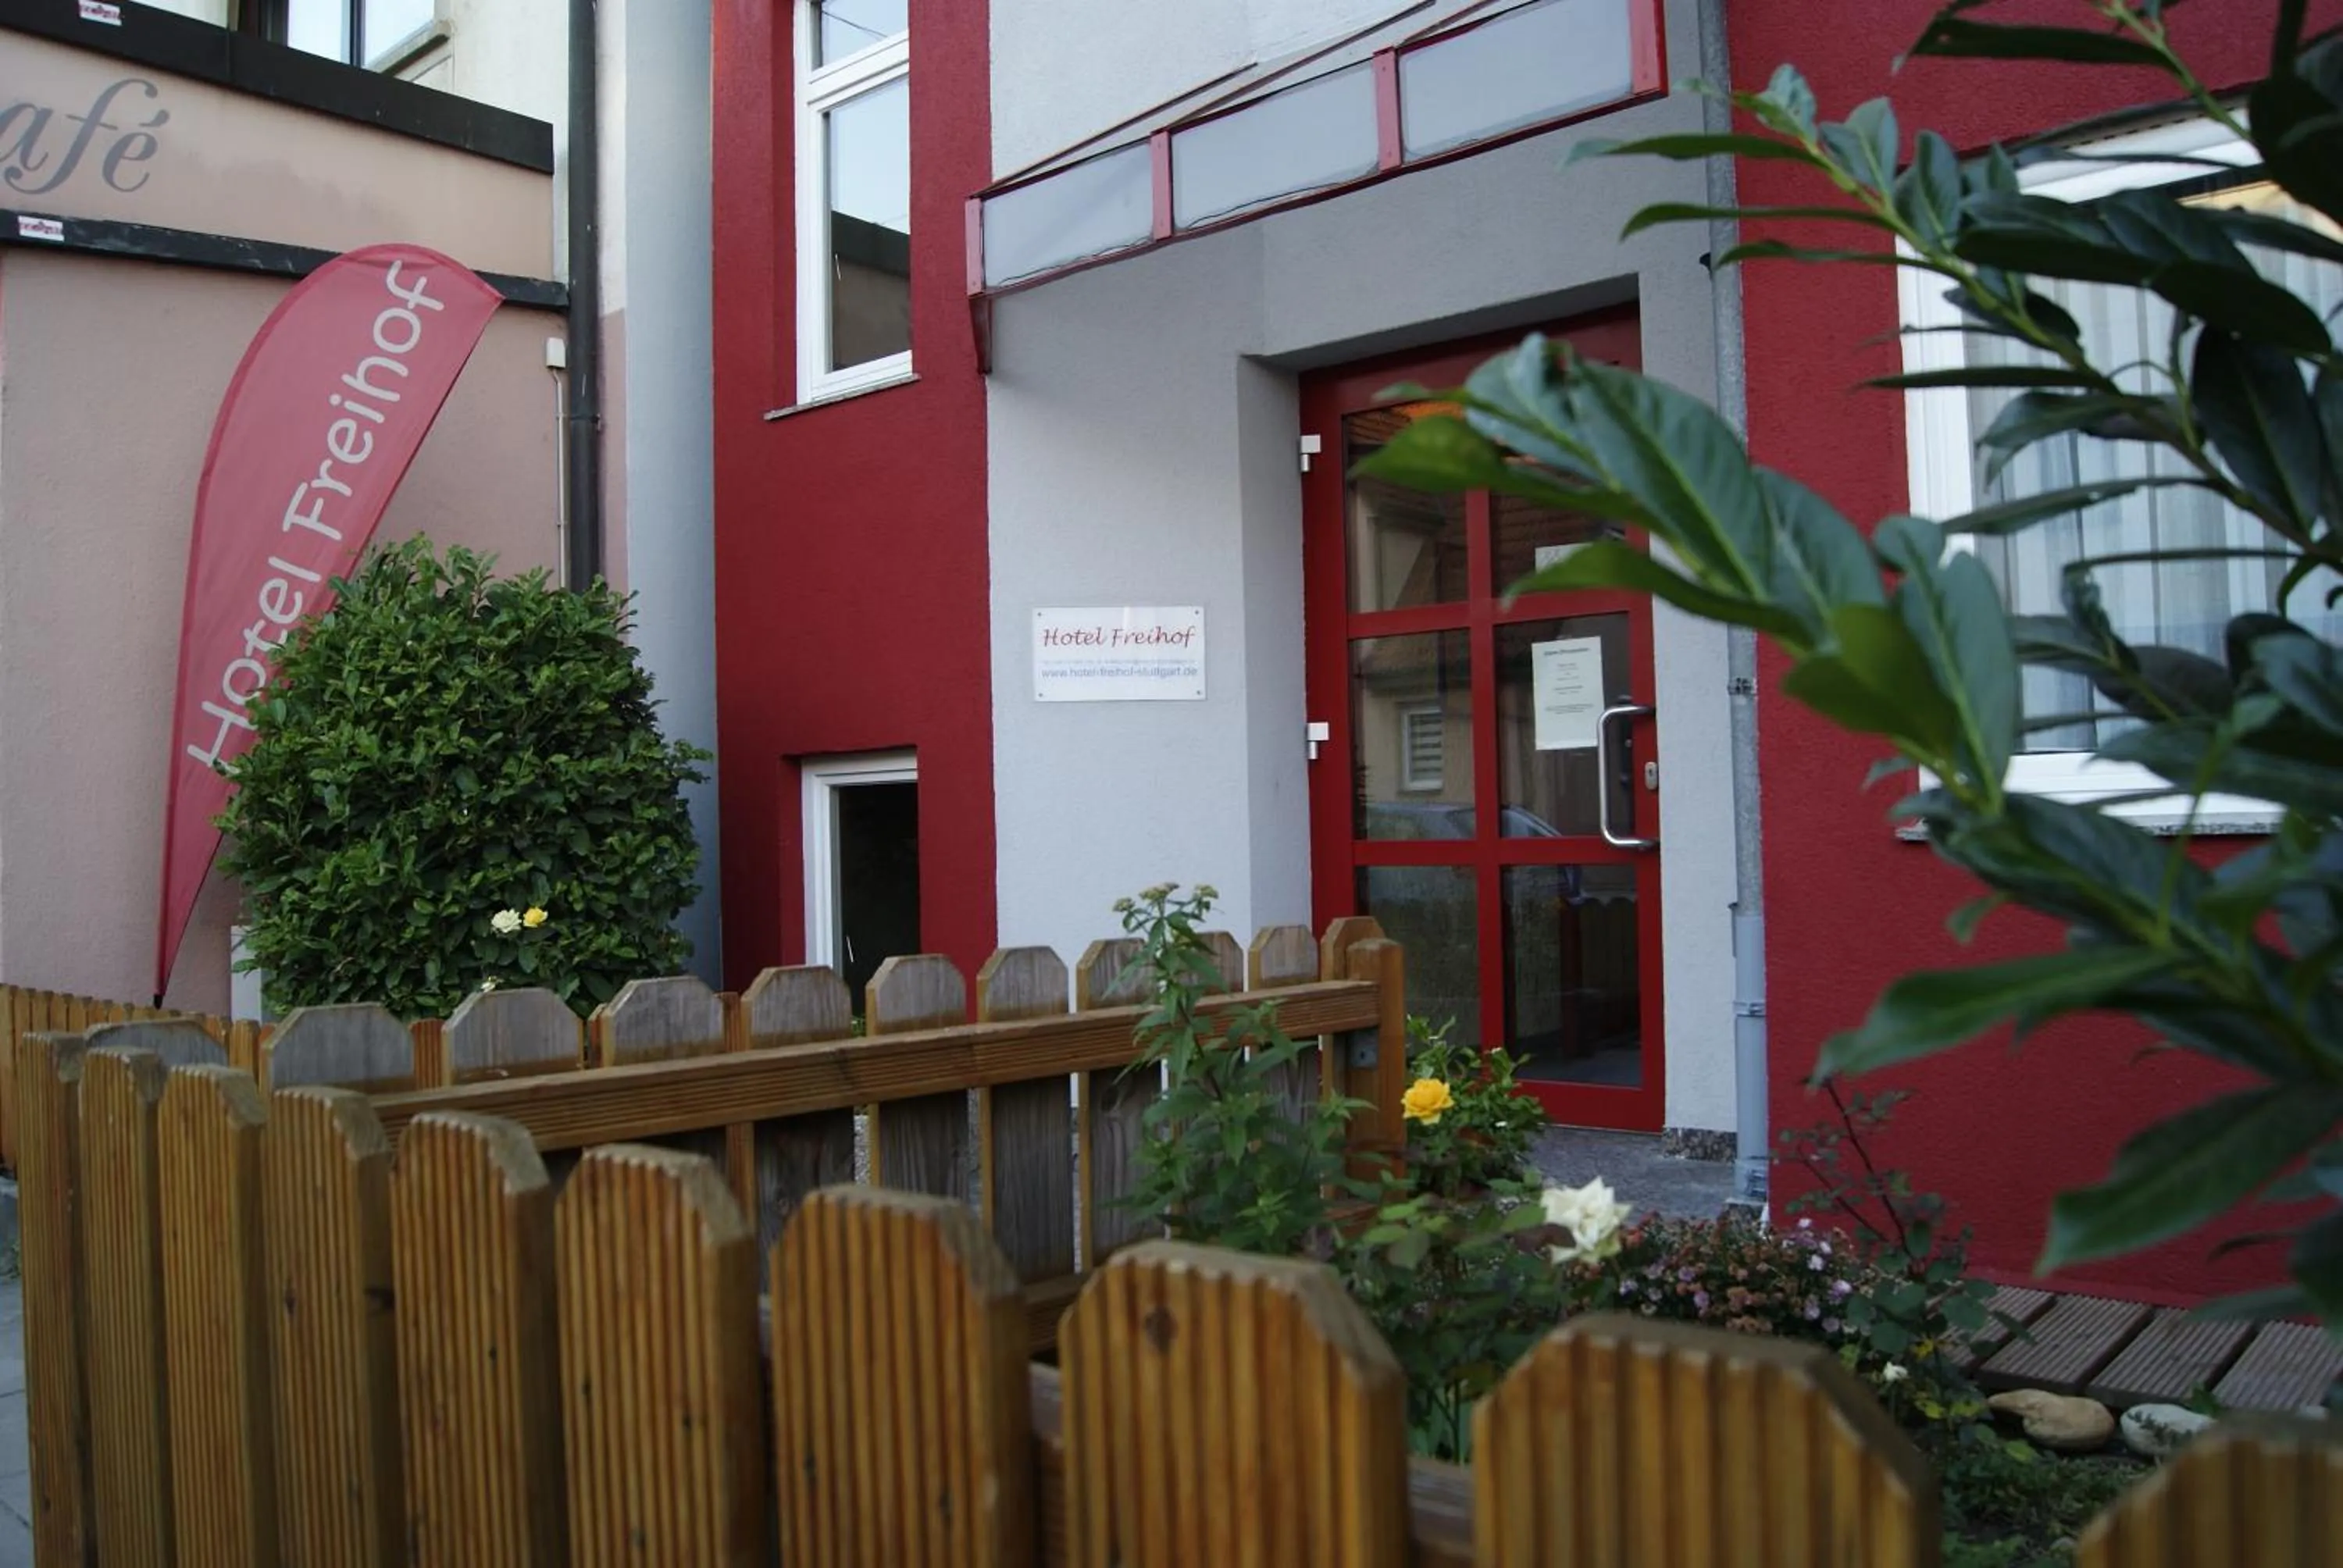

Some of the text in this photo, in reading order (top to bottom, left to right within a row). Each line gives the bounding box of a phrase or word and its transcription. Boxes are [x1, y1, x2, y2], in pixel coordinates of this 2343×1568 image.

[187, 260, 444, 775] Hotel Freihof
[1043, 625, 1196, 649] Hotel Freihof
